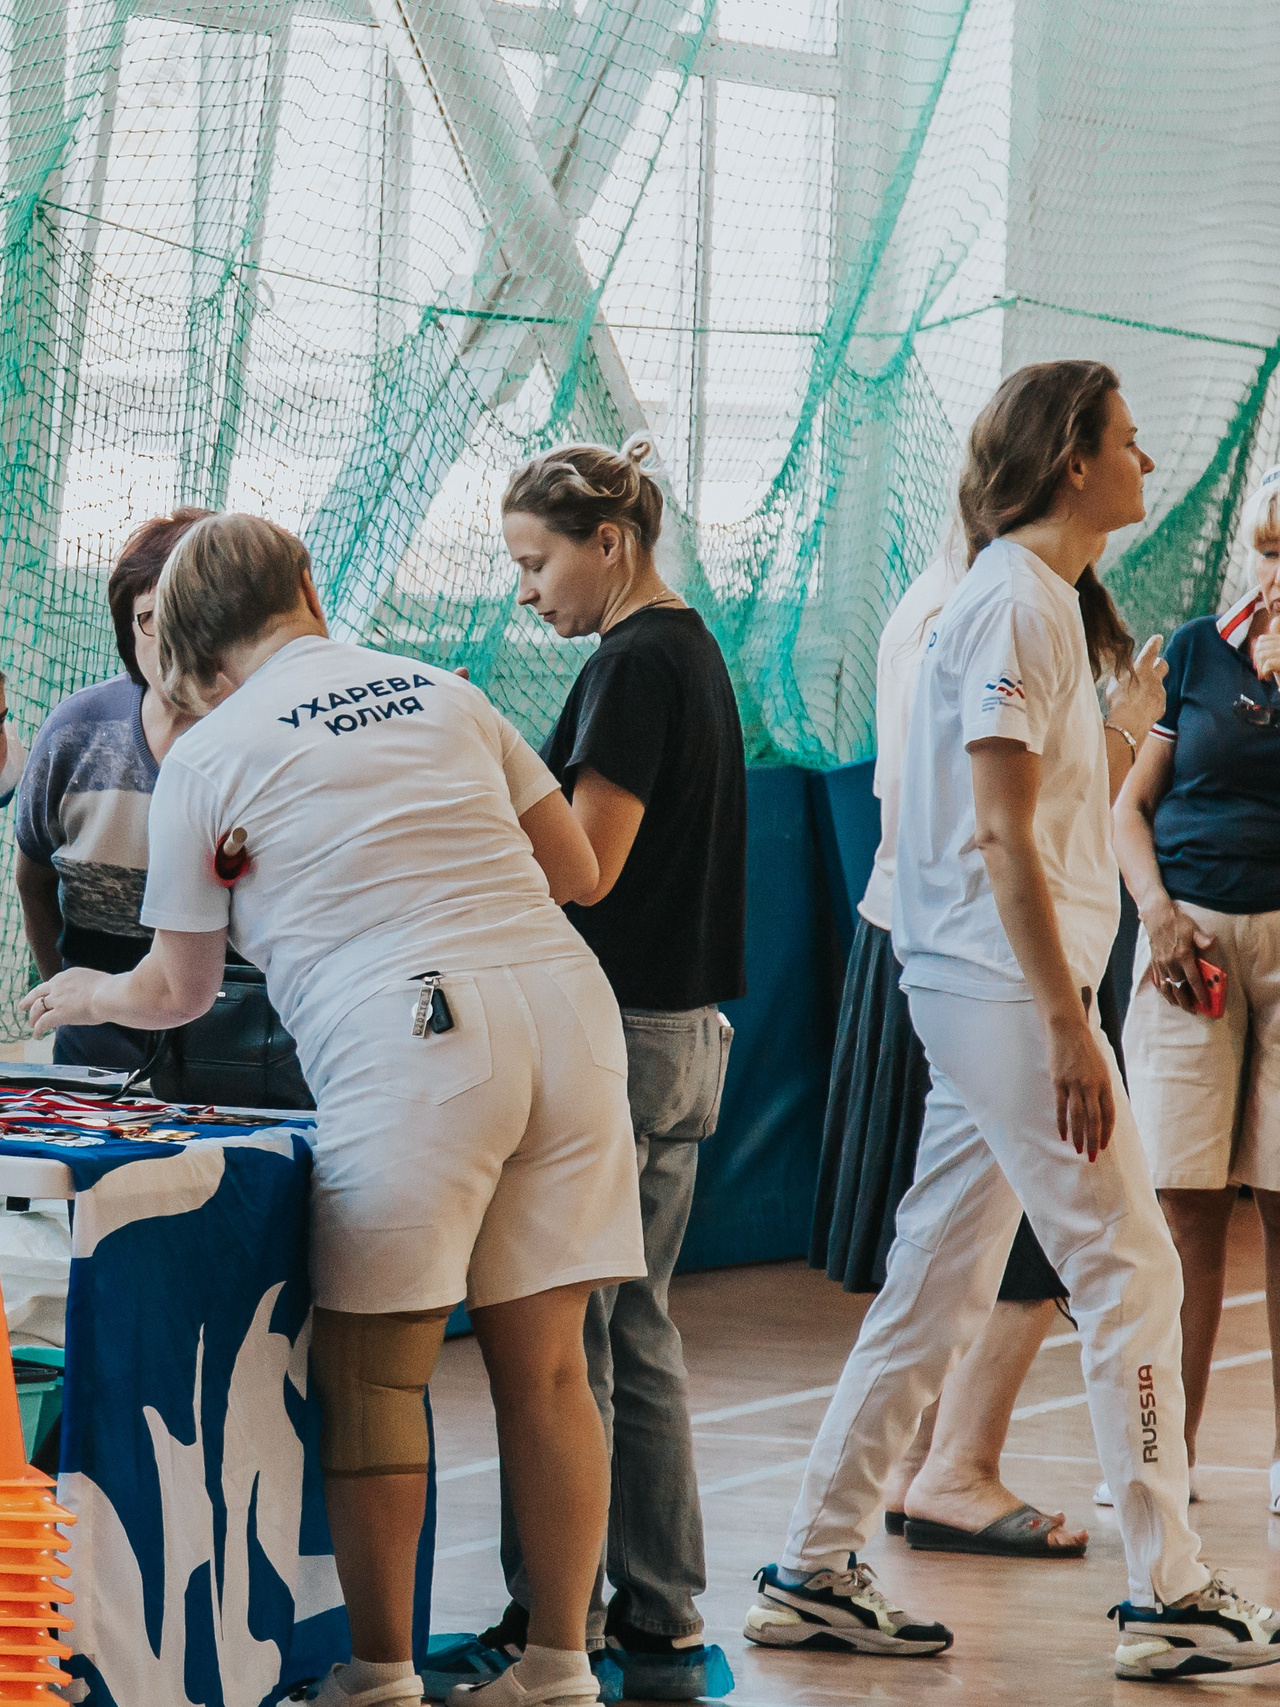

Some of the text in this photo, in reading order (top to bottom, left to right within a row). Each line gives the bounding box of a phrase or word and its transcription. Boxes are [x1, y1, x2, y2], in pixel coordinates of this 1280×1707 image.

[277, 673, 437, 729] УХАРЕВА
[324, 696, 425, 736] ЮЛИЯ
[1137, 1364, 1159, 1464] RUSSIA
